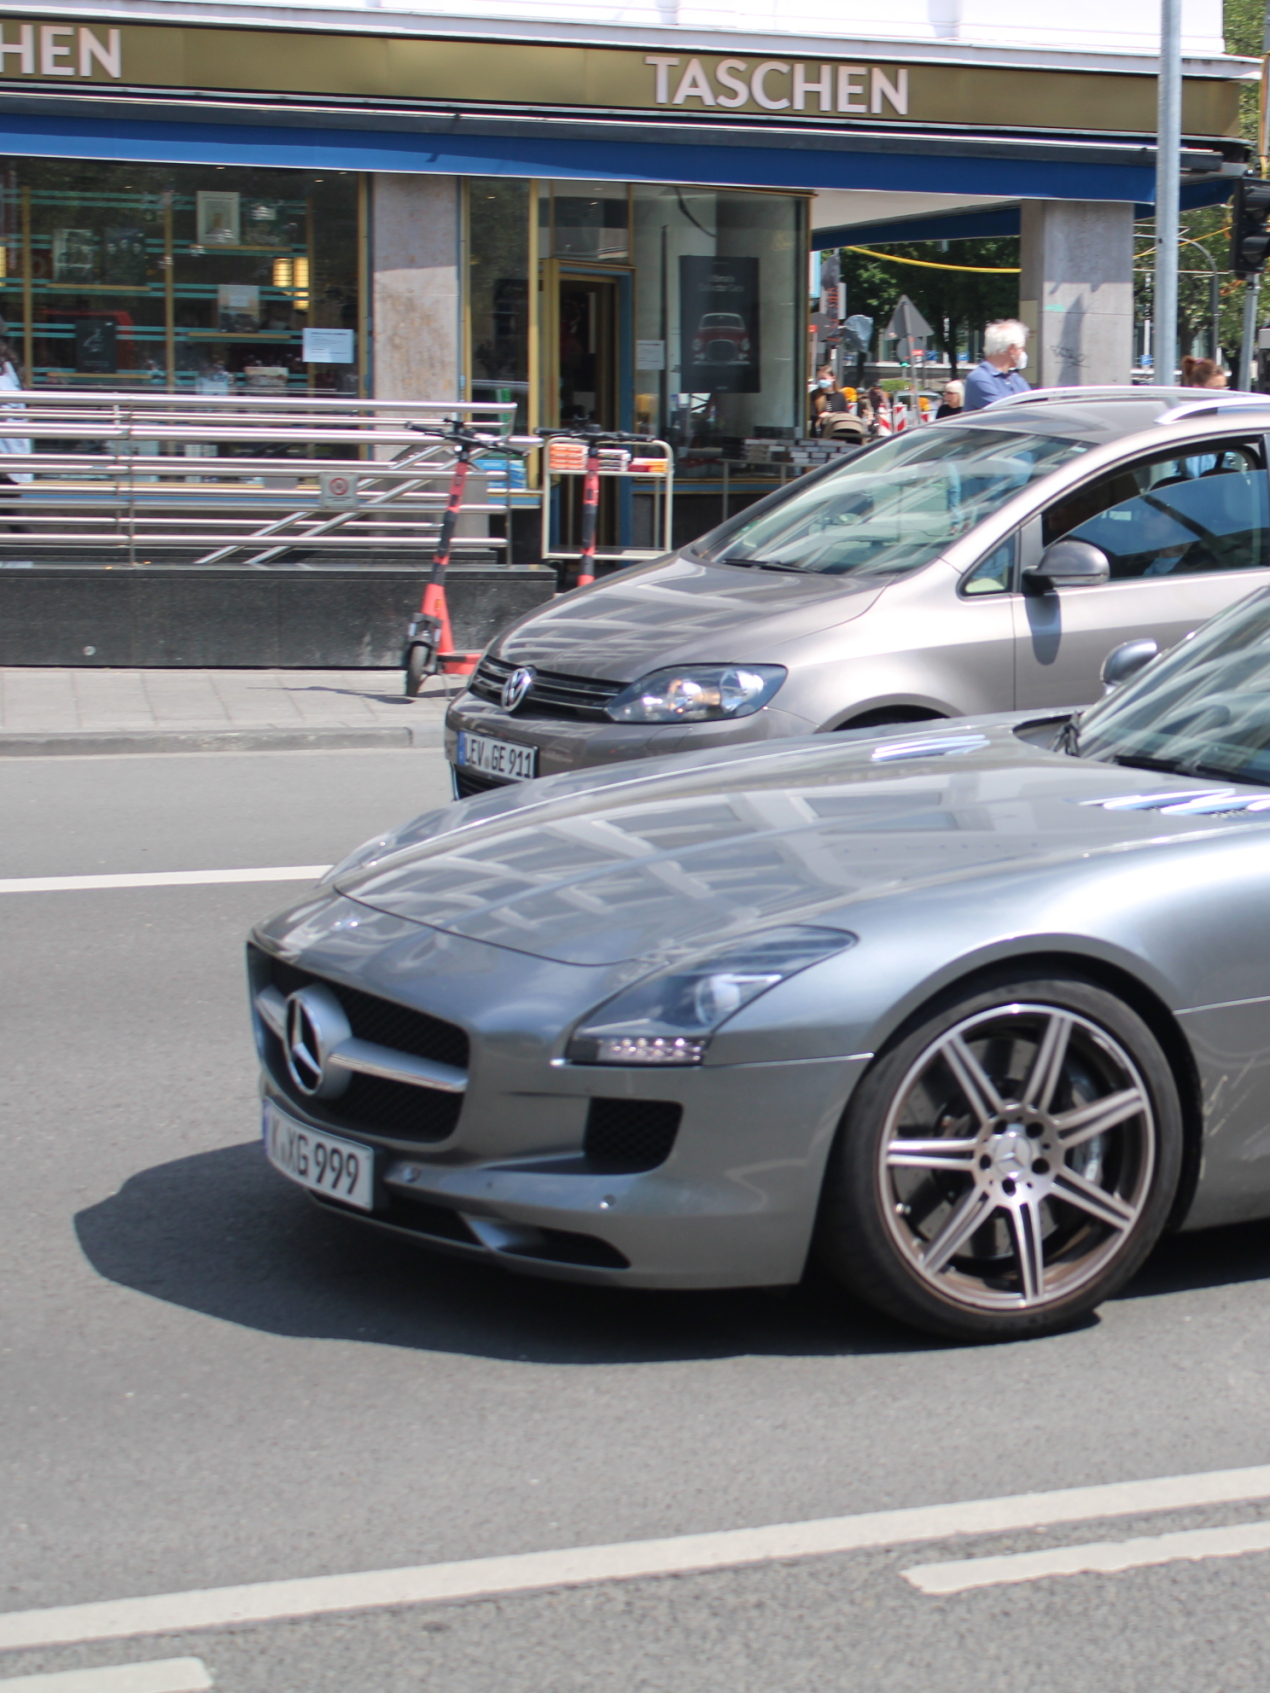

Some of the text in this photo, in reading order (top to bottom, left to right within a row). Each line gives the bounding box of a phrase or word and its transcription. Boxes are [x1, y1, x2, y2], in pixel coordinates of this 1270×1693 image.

[0, 23, 121, 78] HEN
[645, 56, 908, 115] TASCHEN
[466, 738, 531, 779] LEV GE 911
[314, 1141, 359, 1195] 999
